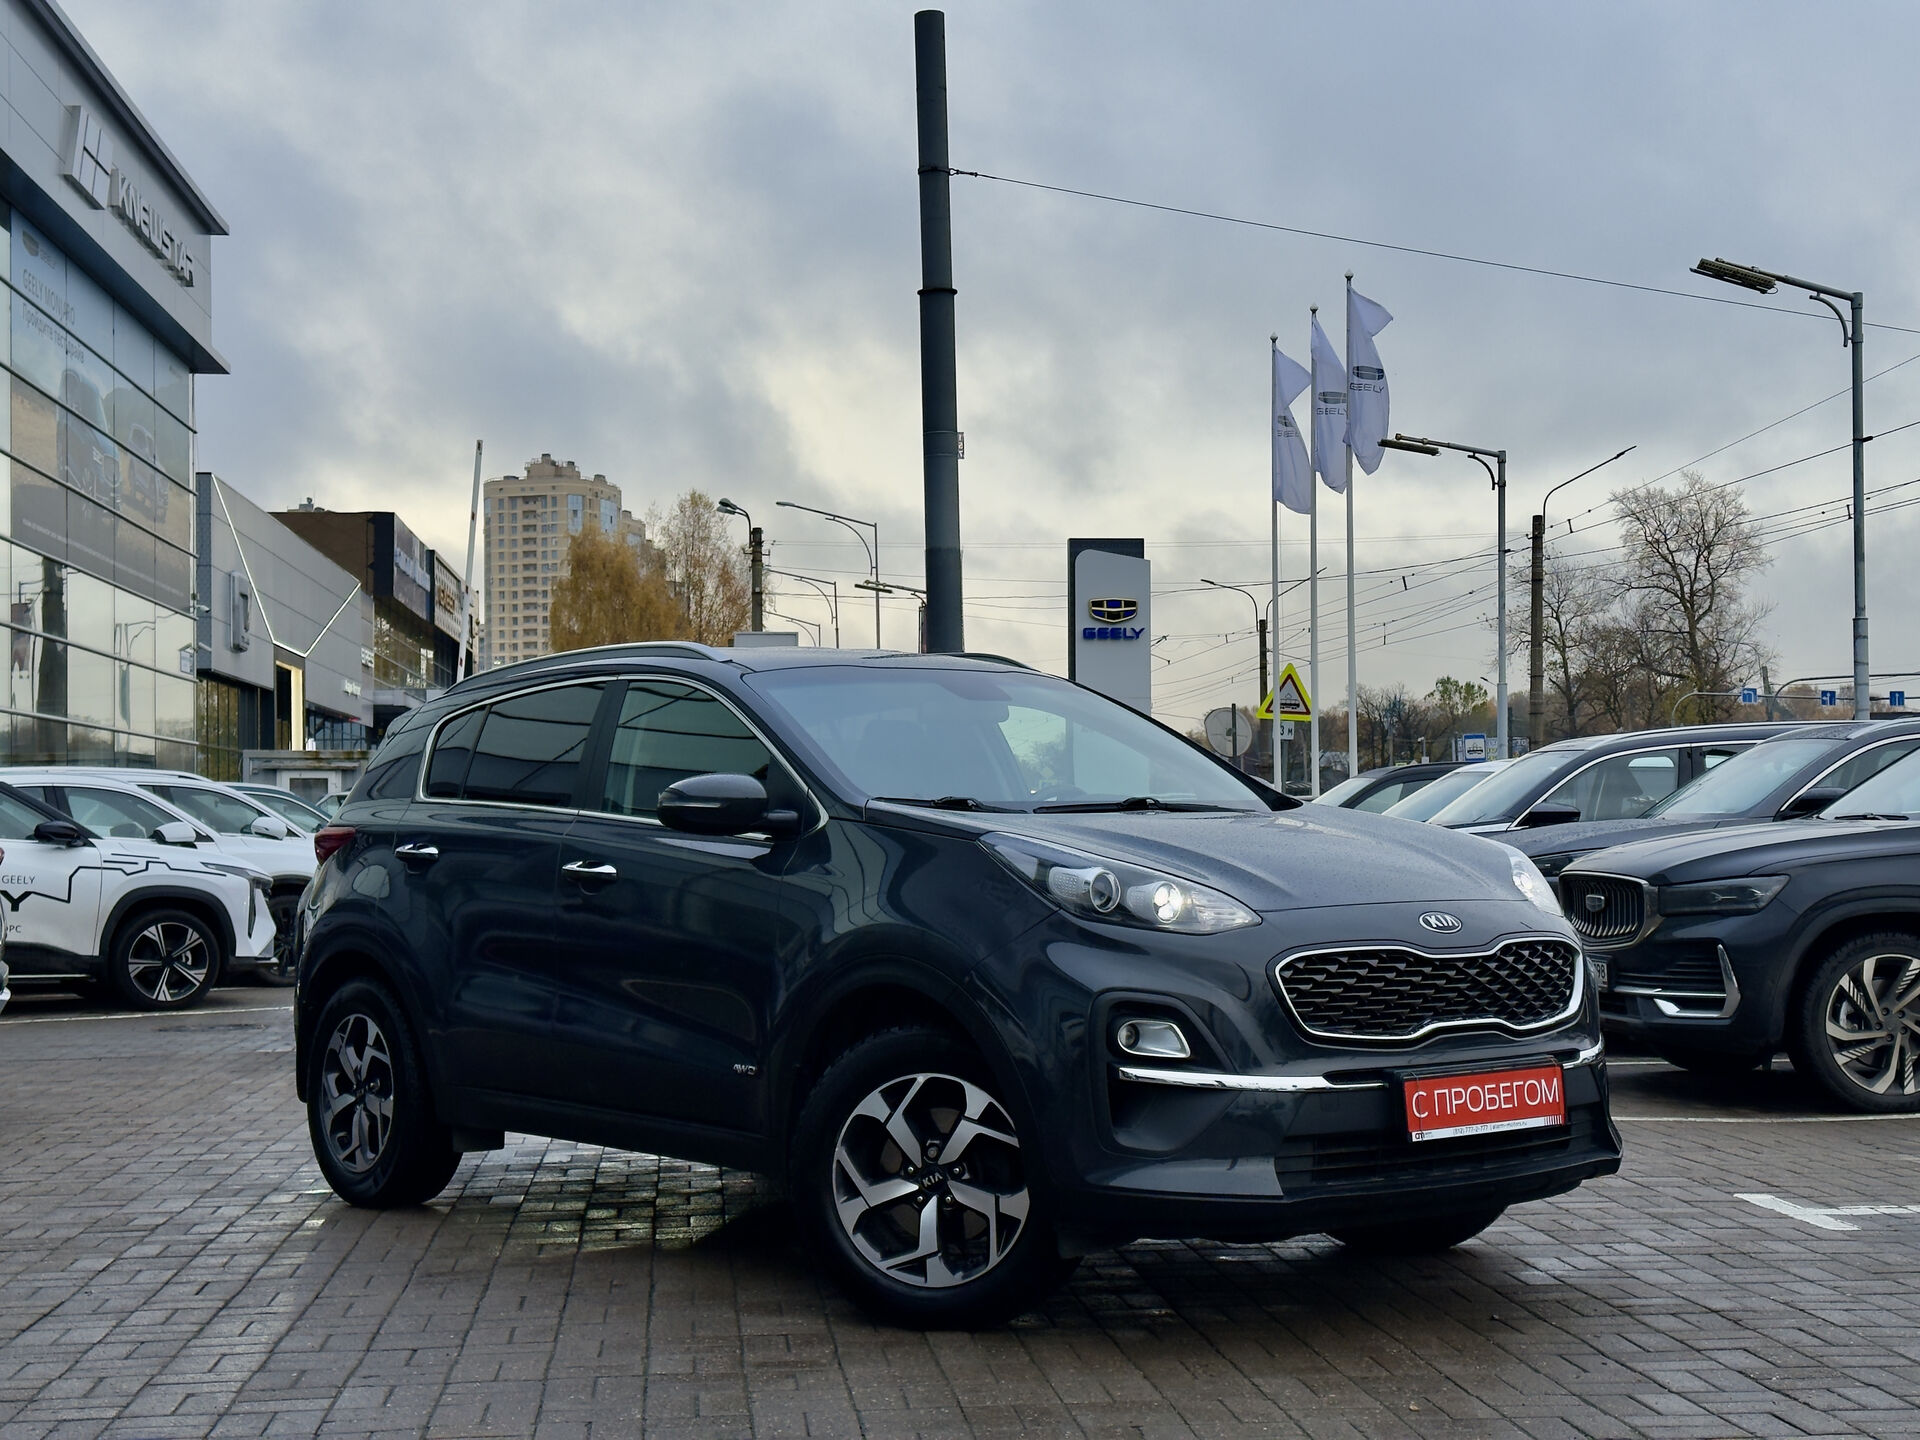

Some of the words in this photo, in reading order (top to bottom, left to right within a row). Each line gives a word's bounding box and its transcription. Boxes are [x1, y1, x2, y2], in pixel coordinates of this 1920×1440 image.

[1349, 382, 1385, 394] GEELY
[1082, 627, 1146, 641] GEELY
[2, 874, 36, 885] GEELY
[1424, 913, 1459, 928] KIA
[1412, 1090, 1429, 1119] С
[1433, 1077, 1560, 1117] ПРОБЕГОМ
[922, 1172, 943, 1188] KIA
